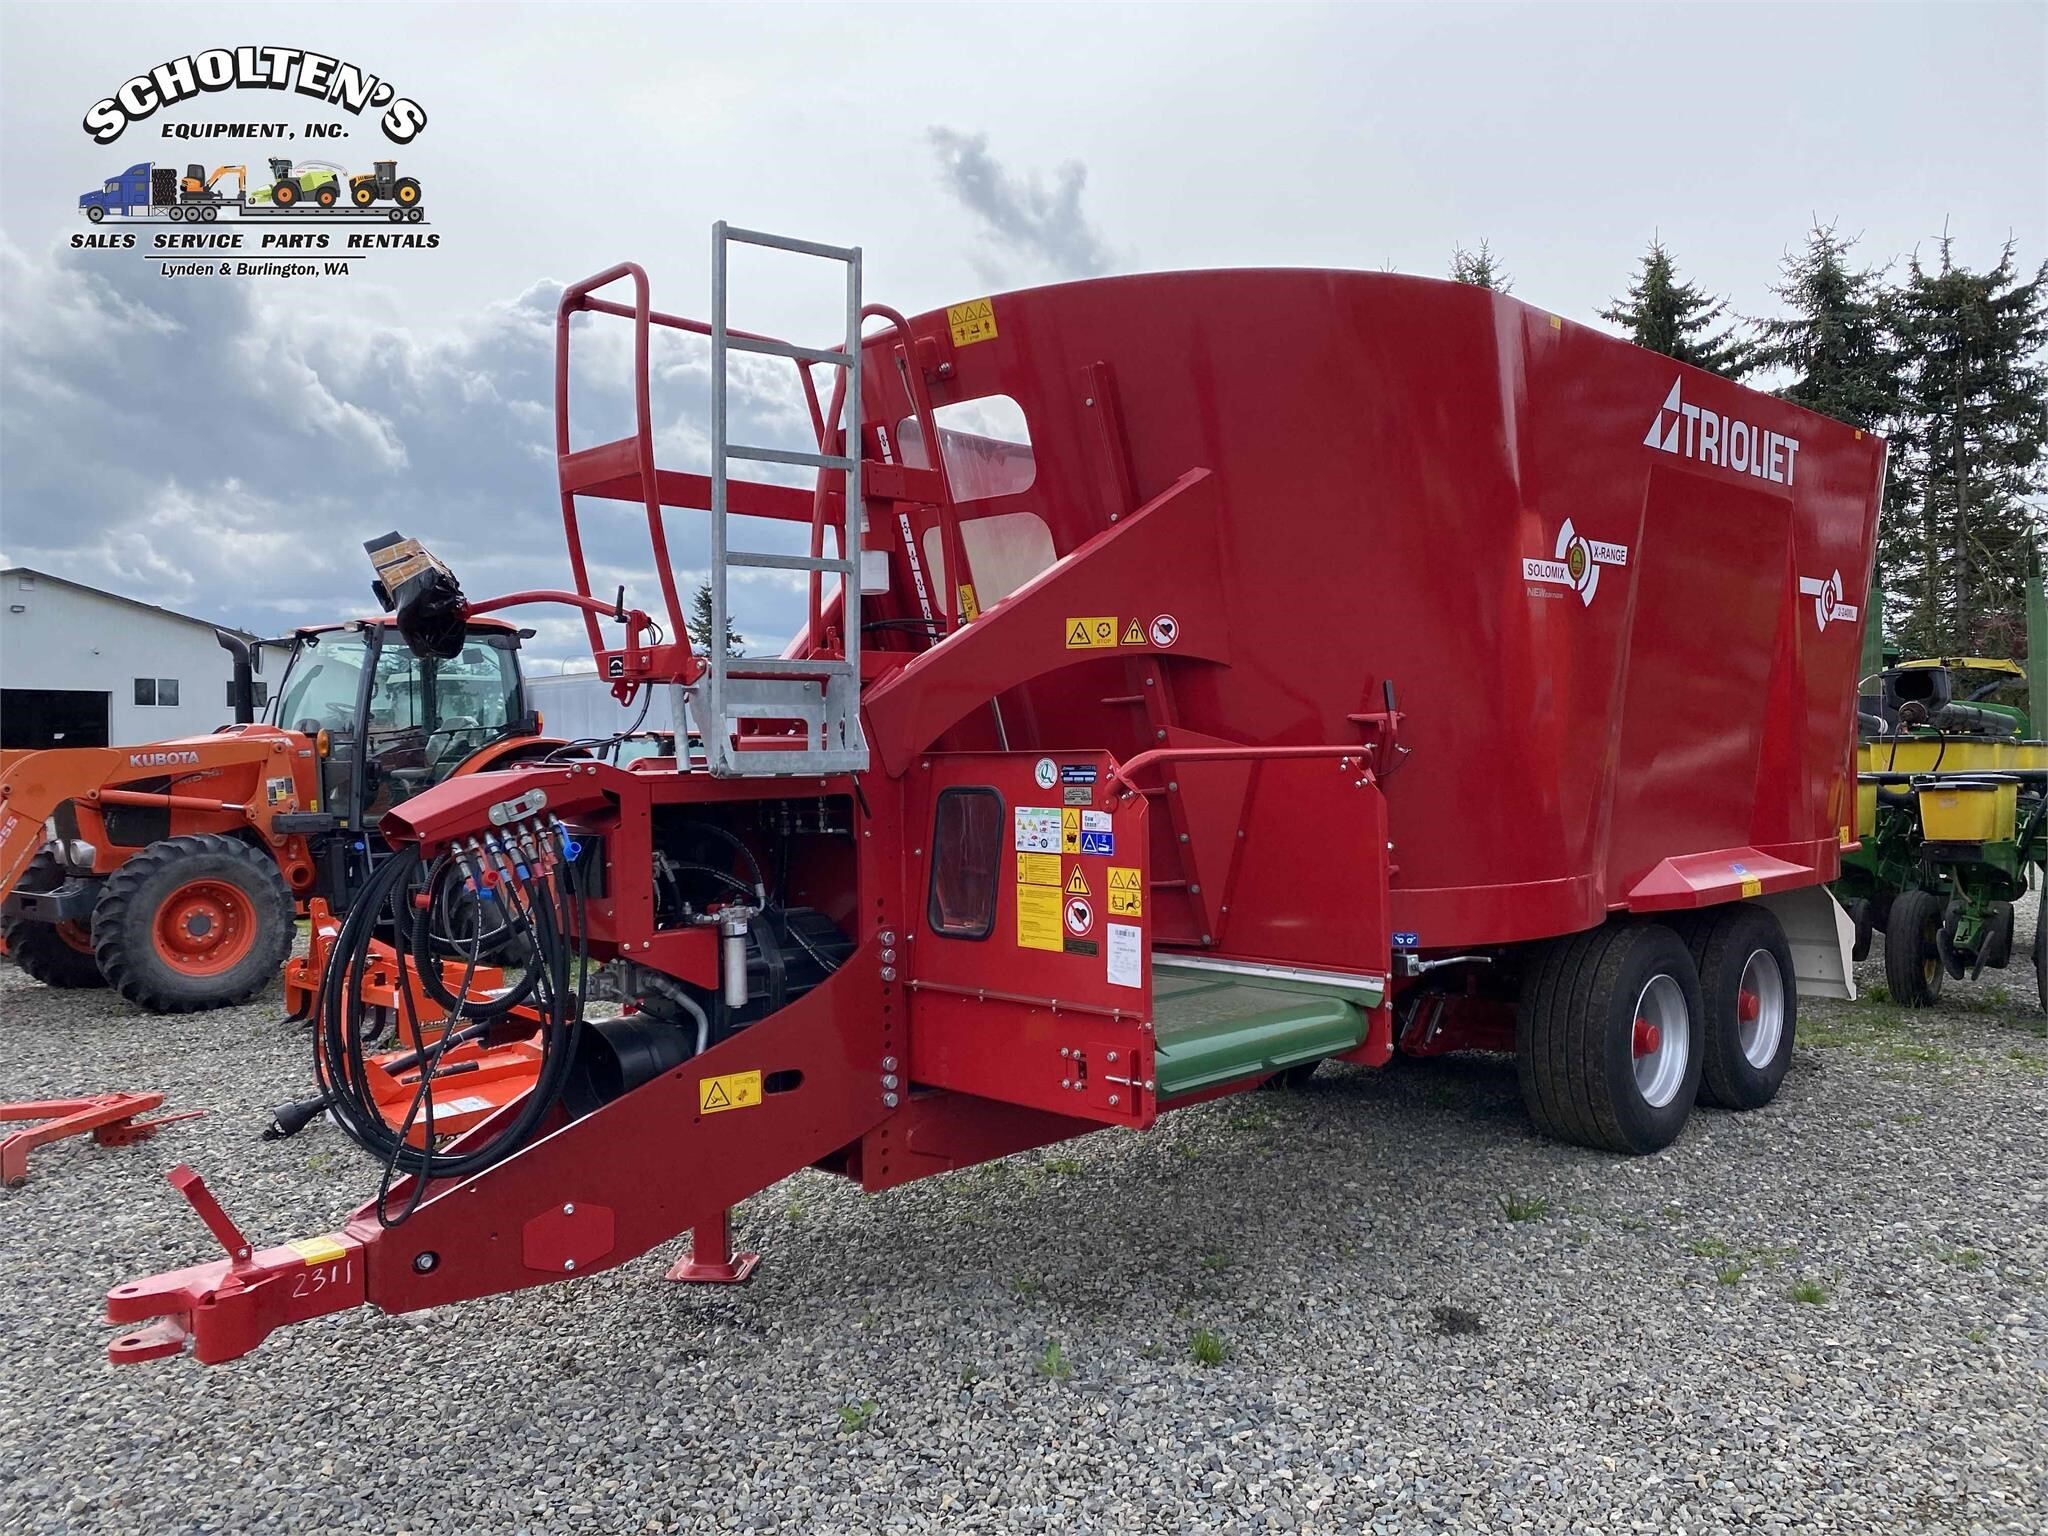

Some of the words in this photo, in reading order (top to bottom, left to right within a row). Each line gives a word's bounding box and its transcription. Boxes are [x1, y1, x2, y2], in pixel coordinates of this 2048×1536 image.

[1682, 402, 1799, 486] TRIOLIET
[1593, 546, 1626, 562] X-RANGE
[1527, 563, 1565, 580] SOLOMIX
[130, 751, 200, 768] KUBOTA
[292, 1260, 352, 1298] 2311
